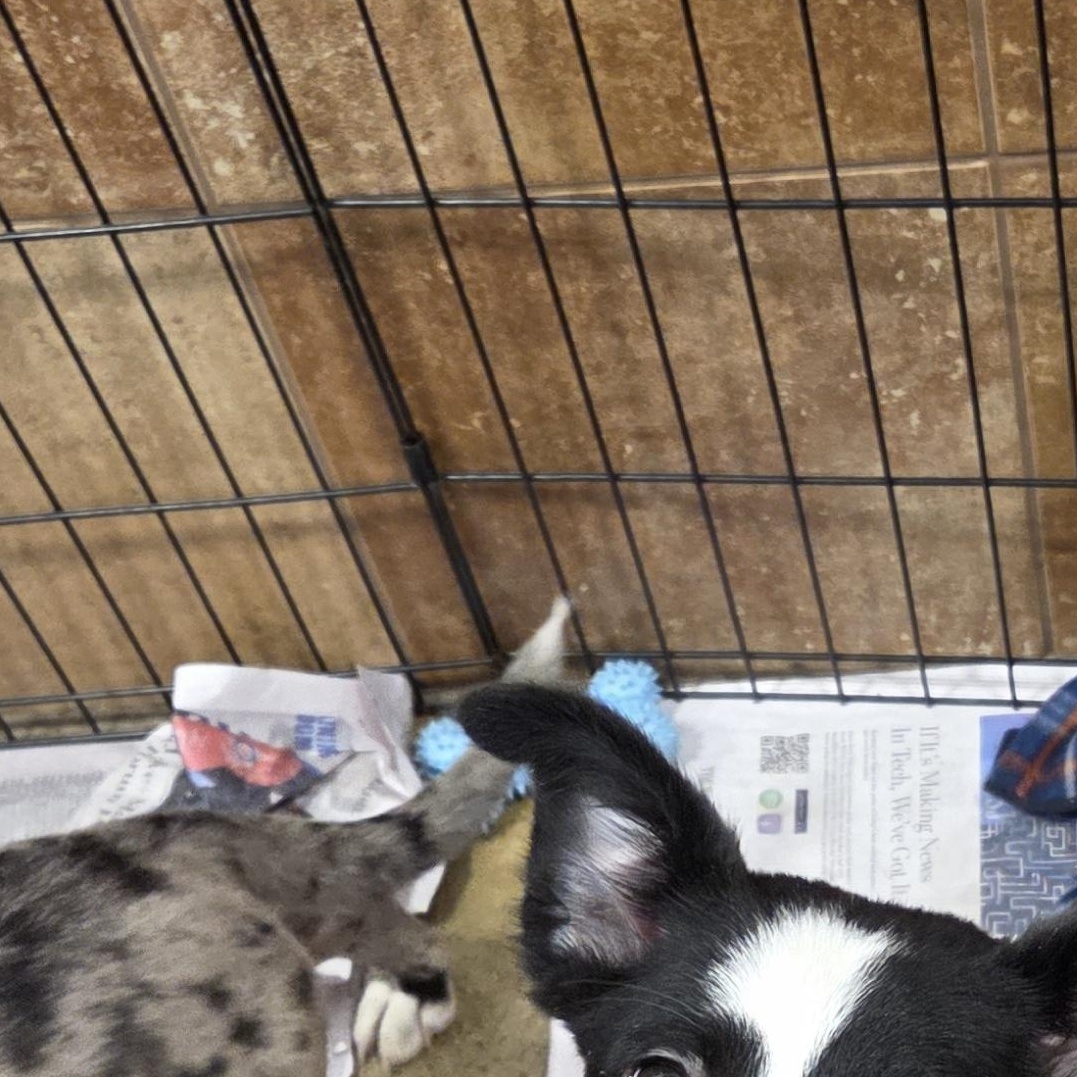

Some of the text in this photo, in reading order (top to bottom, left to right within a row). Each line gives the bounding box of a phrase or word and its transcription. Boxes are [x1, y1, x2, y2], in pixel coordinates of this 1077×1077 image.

[890, 728, 912, 742] In
[888, 746, 912, 790] Tech,
[889, 796, 911, 842] We've
[911, 771, 941, 833] Making
[888, 847, 911, 878] Got
[918, 838, 940, 883] News
